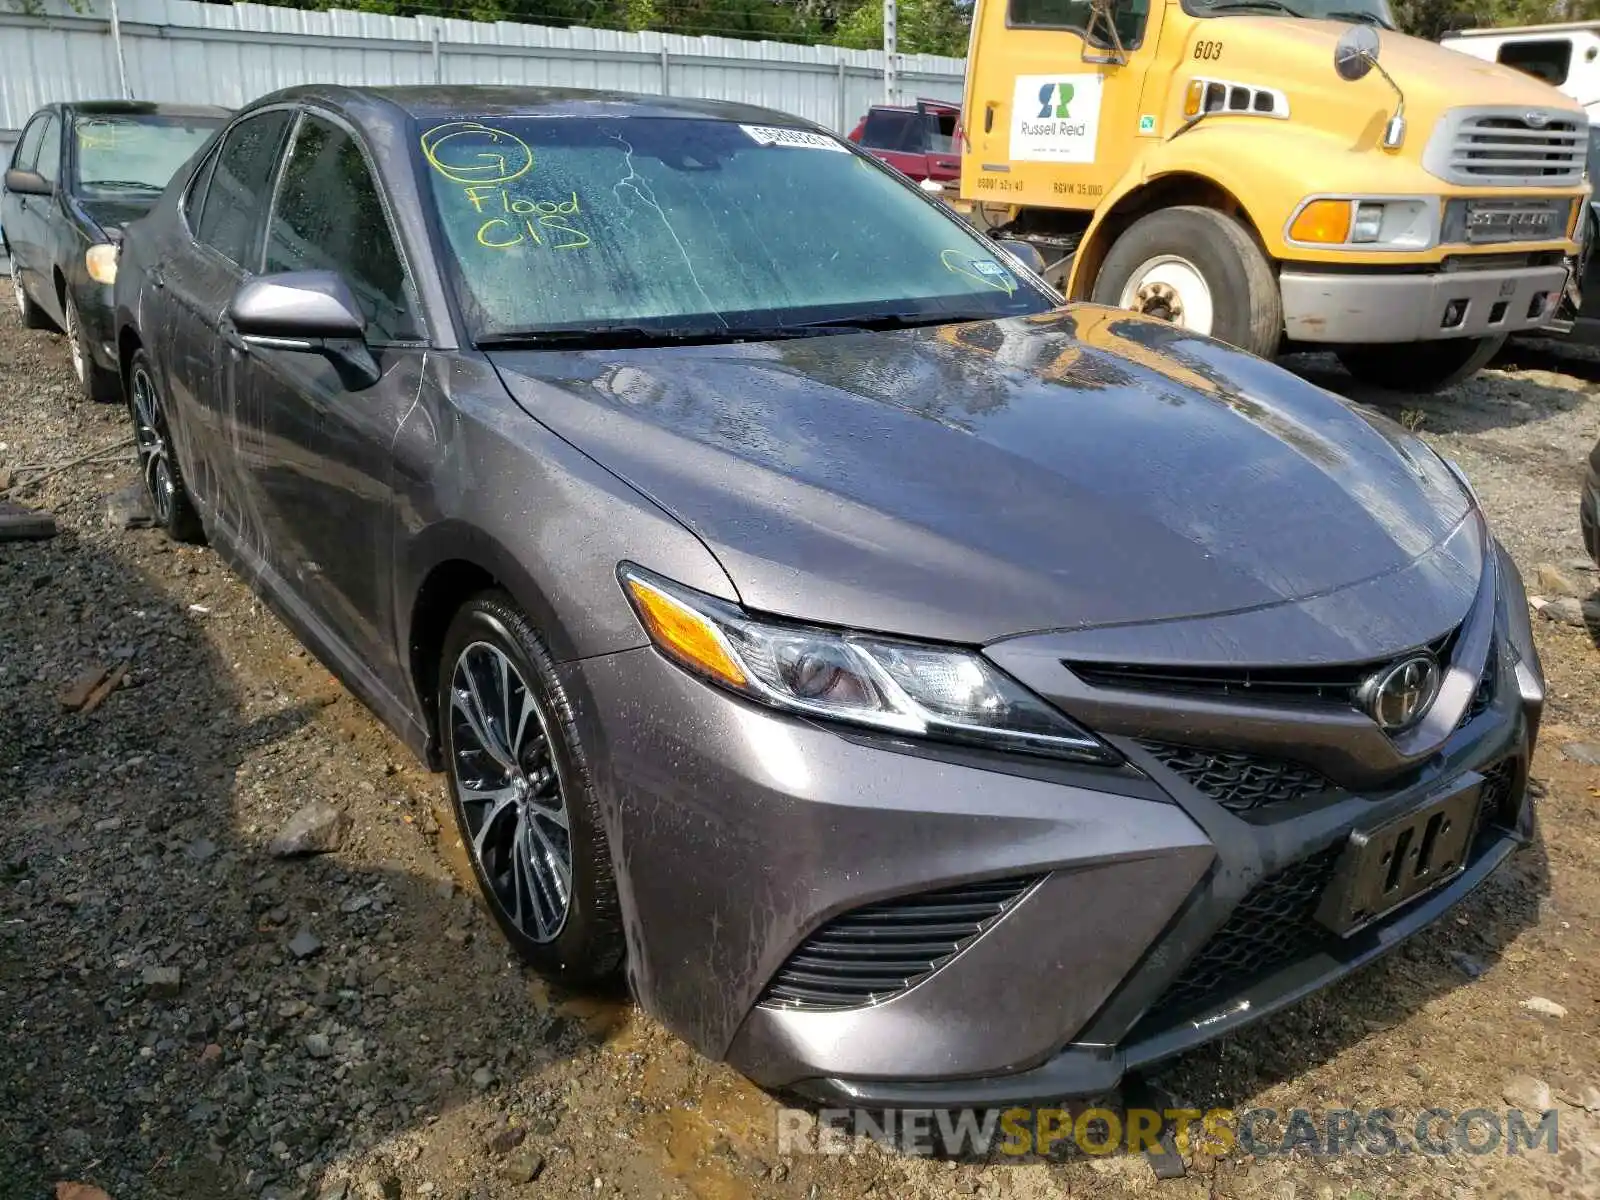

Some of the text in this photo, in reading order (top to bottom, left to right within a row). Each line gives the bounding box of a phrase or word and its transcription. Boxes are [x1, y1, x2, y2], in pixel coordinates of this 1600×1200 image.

[1194, 41, 1222, 60] 603
[1021, 121, 1085, 136] Russell Reid
[464, 186, 580, 214] Flood
